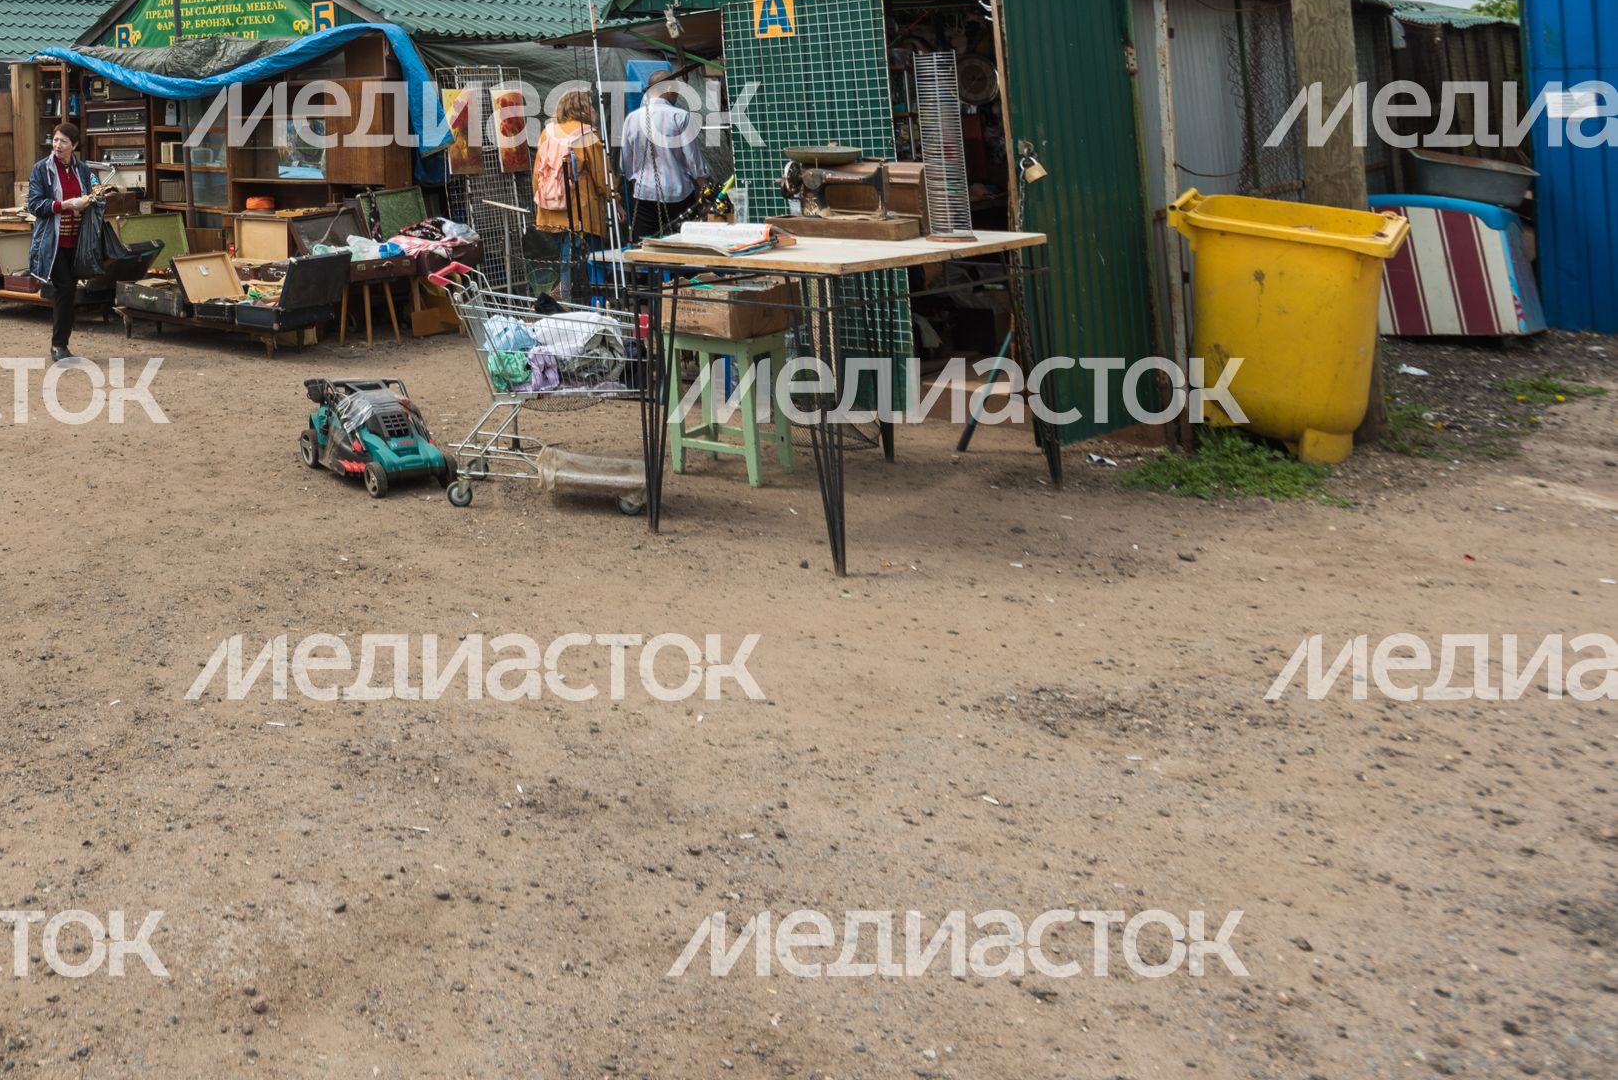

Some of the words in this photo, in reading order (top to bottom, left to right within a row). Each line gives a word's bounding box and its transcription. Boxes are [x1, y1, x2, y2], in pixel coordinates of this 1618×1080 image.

[146, 6, 193, 19] ПРЕДМТЫ
[194, 3, 244, 16] СТАРИНЫ,
[246, 0, 286, 12] МЕБЕЛЬ,
[156, 18, 194, 31] ФАРОР,
[195, 16, 234, 28] БРОНЗА,
[236, 14, 275, 26] СТЕКЛО
